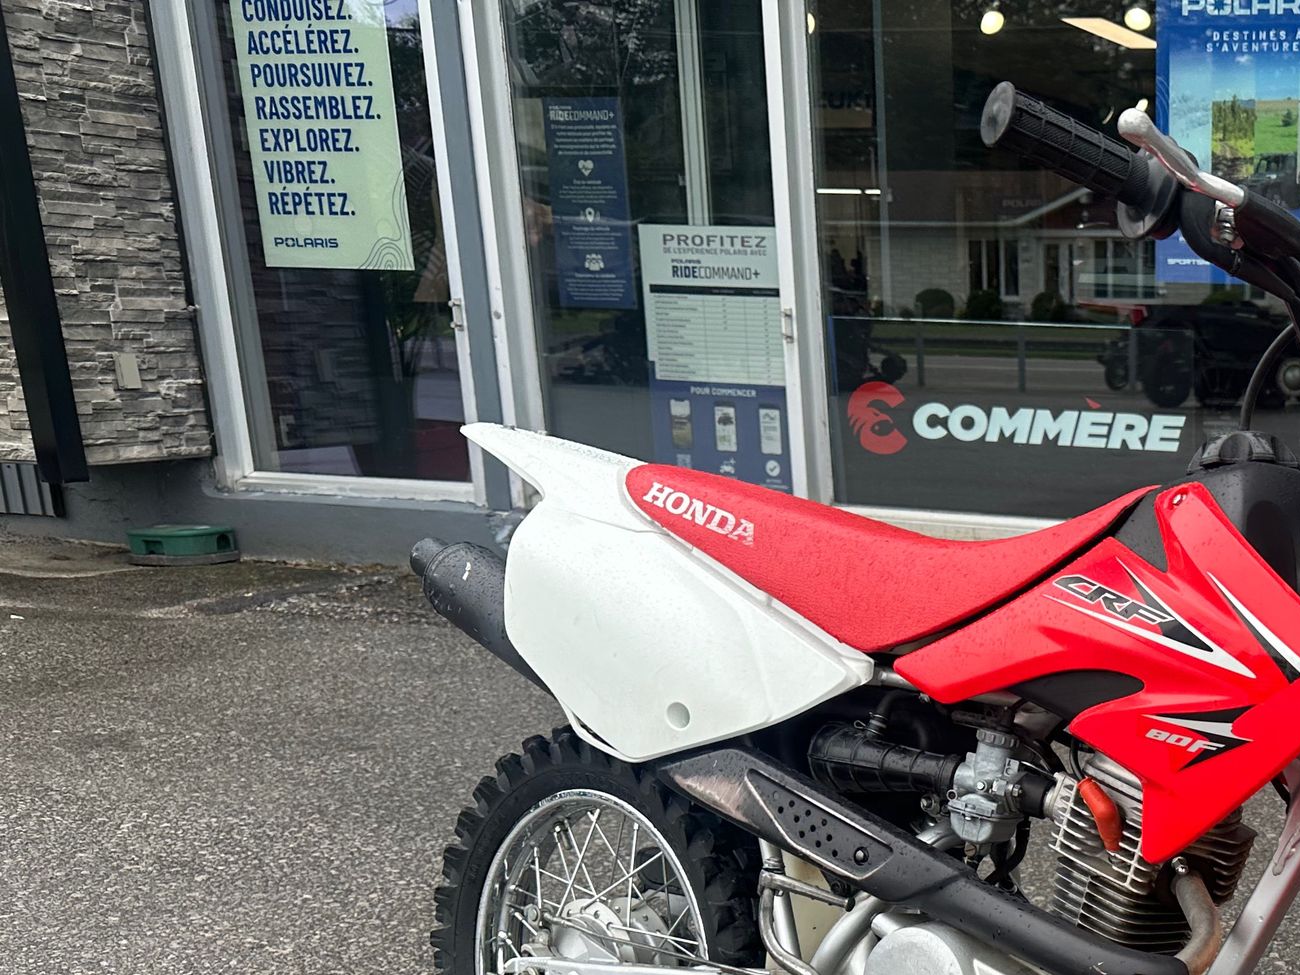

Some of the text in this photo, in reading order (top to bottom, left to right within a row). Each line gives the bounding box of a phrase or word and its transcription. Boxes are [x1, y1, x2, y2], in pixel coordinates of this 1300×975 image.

[242, 0, 352, 22] CONDUISEZ.
[247, 24, 359, 55] ACCÉLÉREZ.
[1213, 28, 1287, 41] DESTINÉS
[250, 62, 373, 88] POURSUIVEZ.
[255, 95, 381, 120] RASSEMBLEZ.
[259, 128, 360, 152] EXPLOREZ.
[263, 160, 336, 184] VIBREZ.
[267, 186, 356, 216] RÉPÉTEZ.
[274, 237, 339, 249] POLARIS
[662, 233, 767, 249] PROFITEZ
[671, 265, 760, 281] RIDECOMMAND+
[912, 397, 1187, 452] COMMÈRE
[643, 481, 756, 546] HONDA
[1052, 573, 1176, 625] CRF
[1145, 728, 1226, 753] 80F
